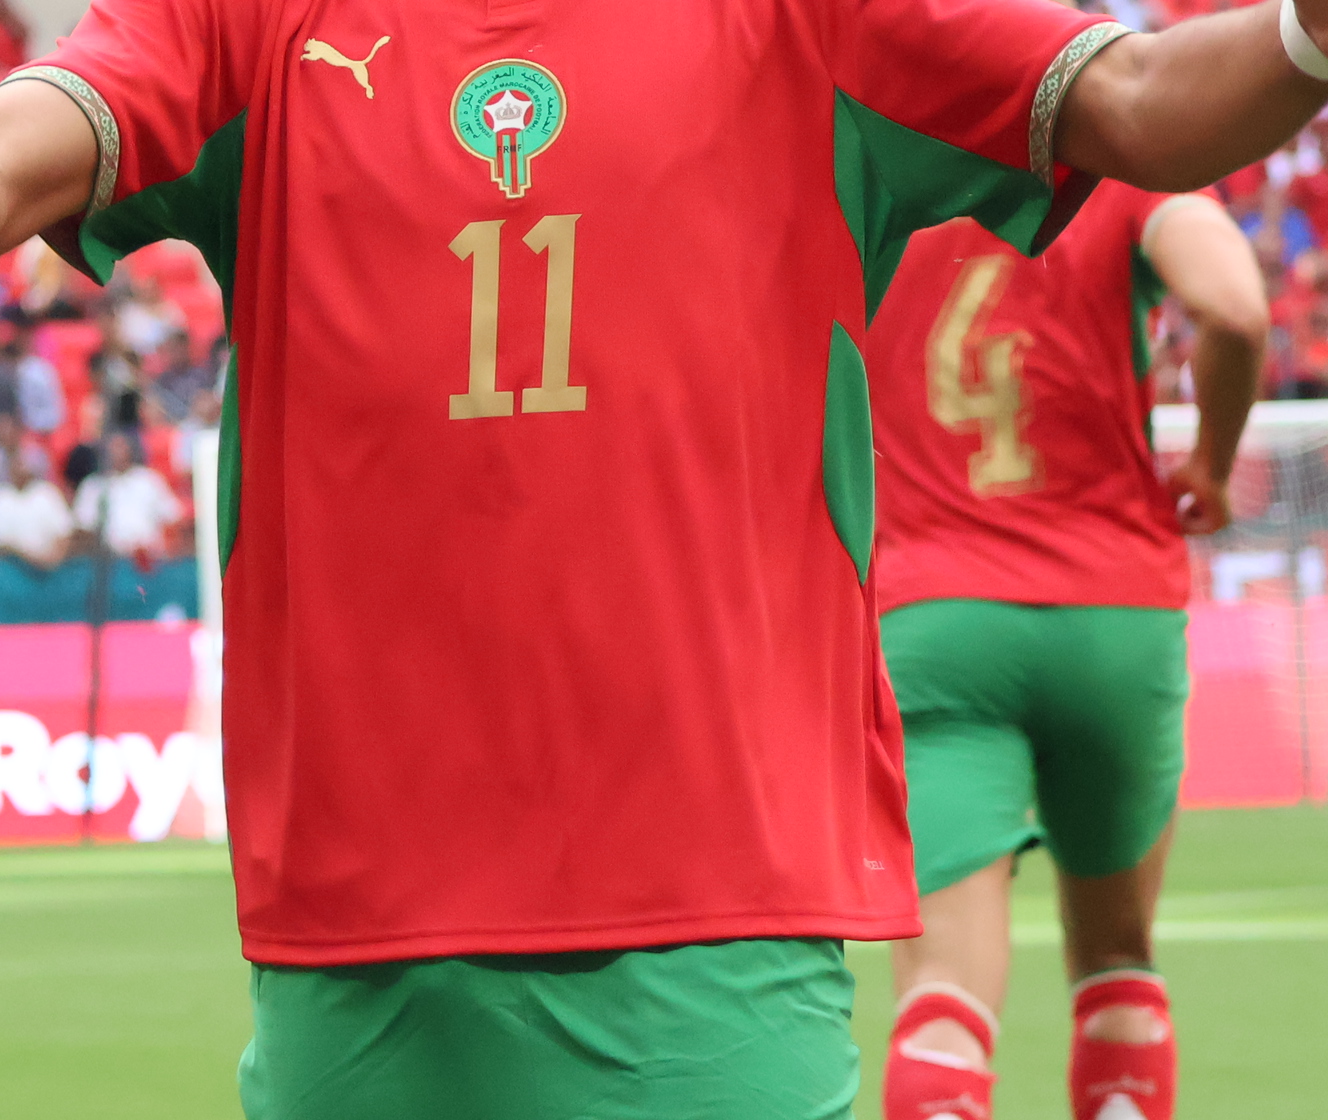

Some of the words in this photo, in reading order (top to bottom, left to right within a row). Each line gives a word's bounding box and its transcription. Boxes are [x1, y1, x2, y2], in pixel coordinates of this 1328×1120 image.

[478, 85, 499, 105] ROYALE
[499, 81, 535, 95] MAROCAINE
[447, 213, 588, 421] 11
[925, 253, 1046, 501] 4
